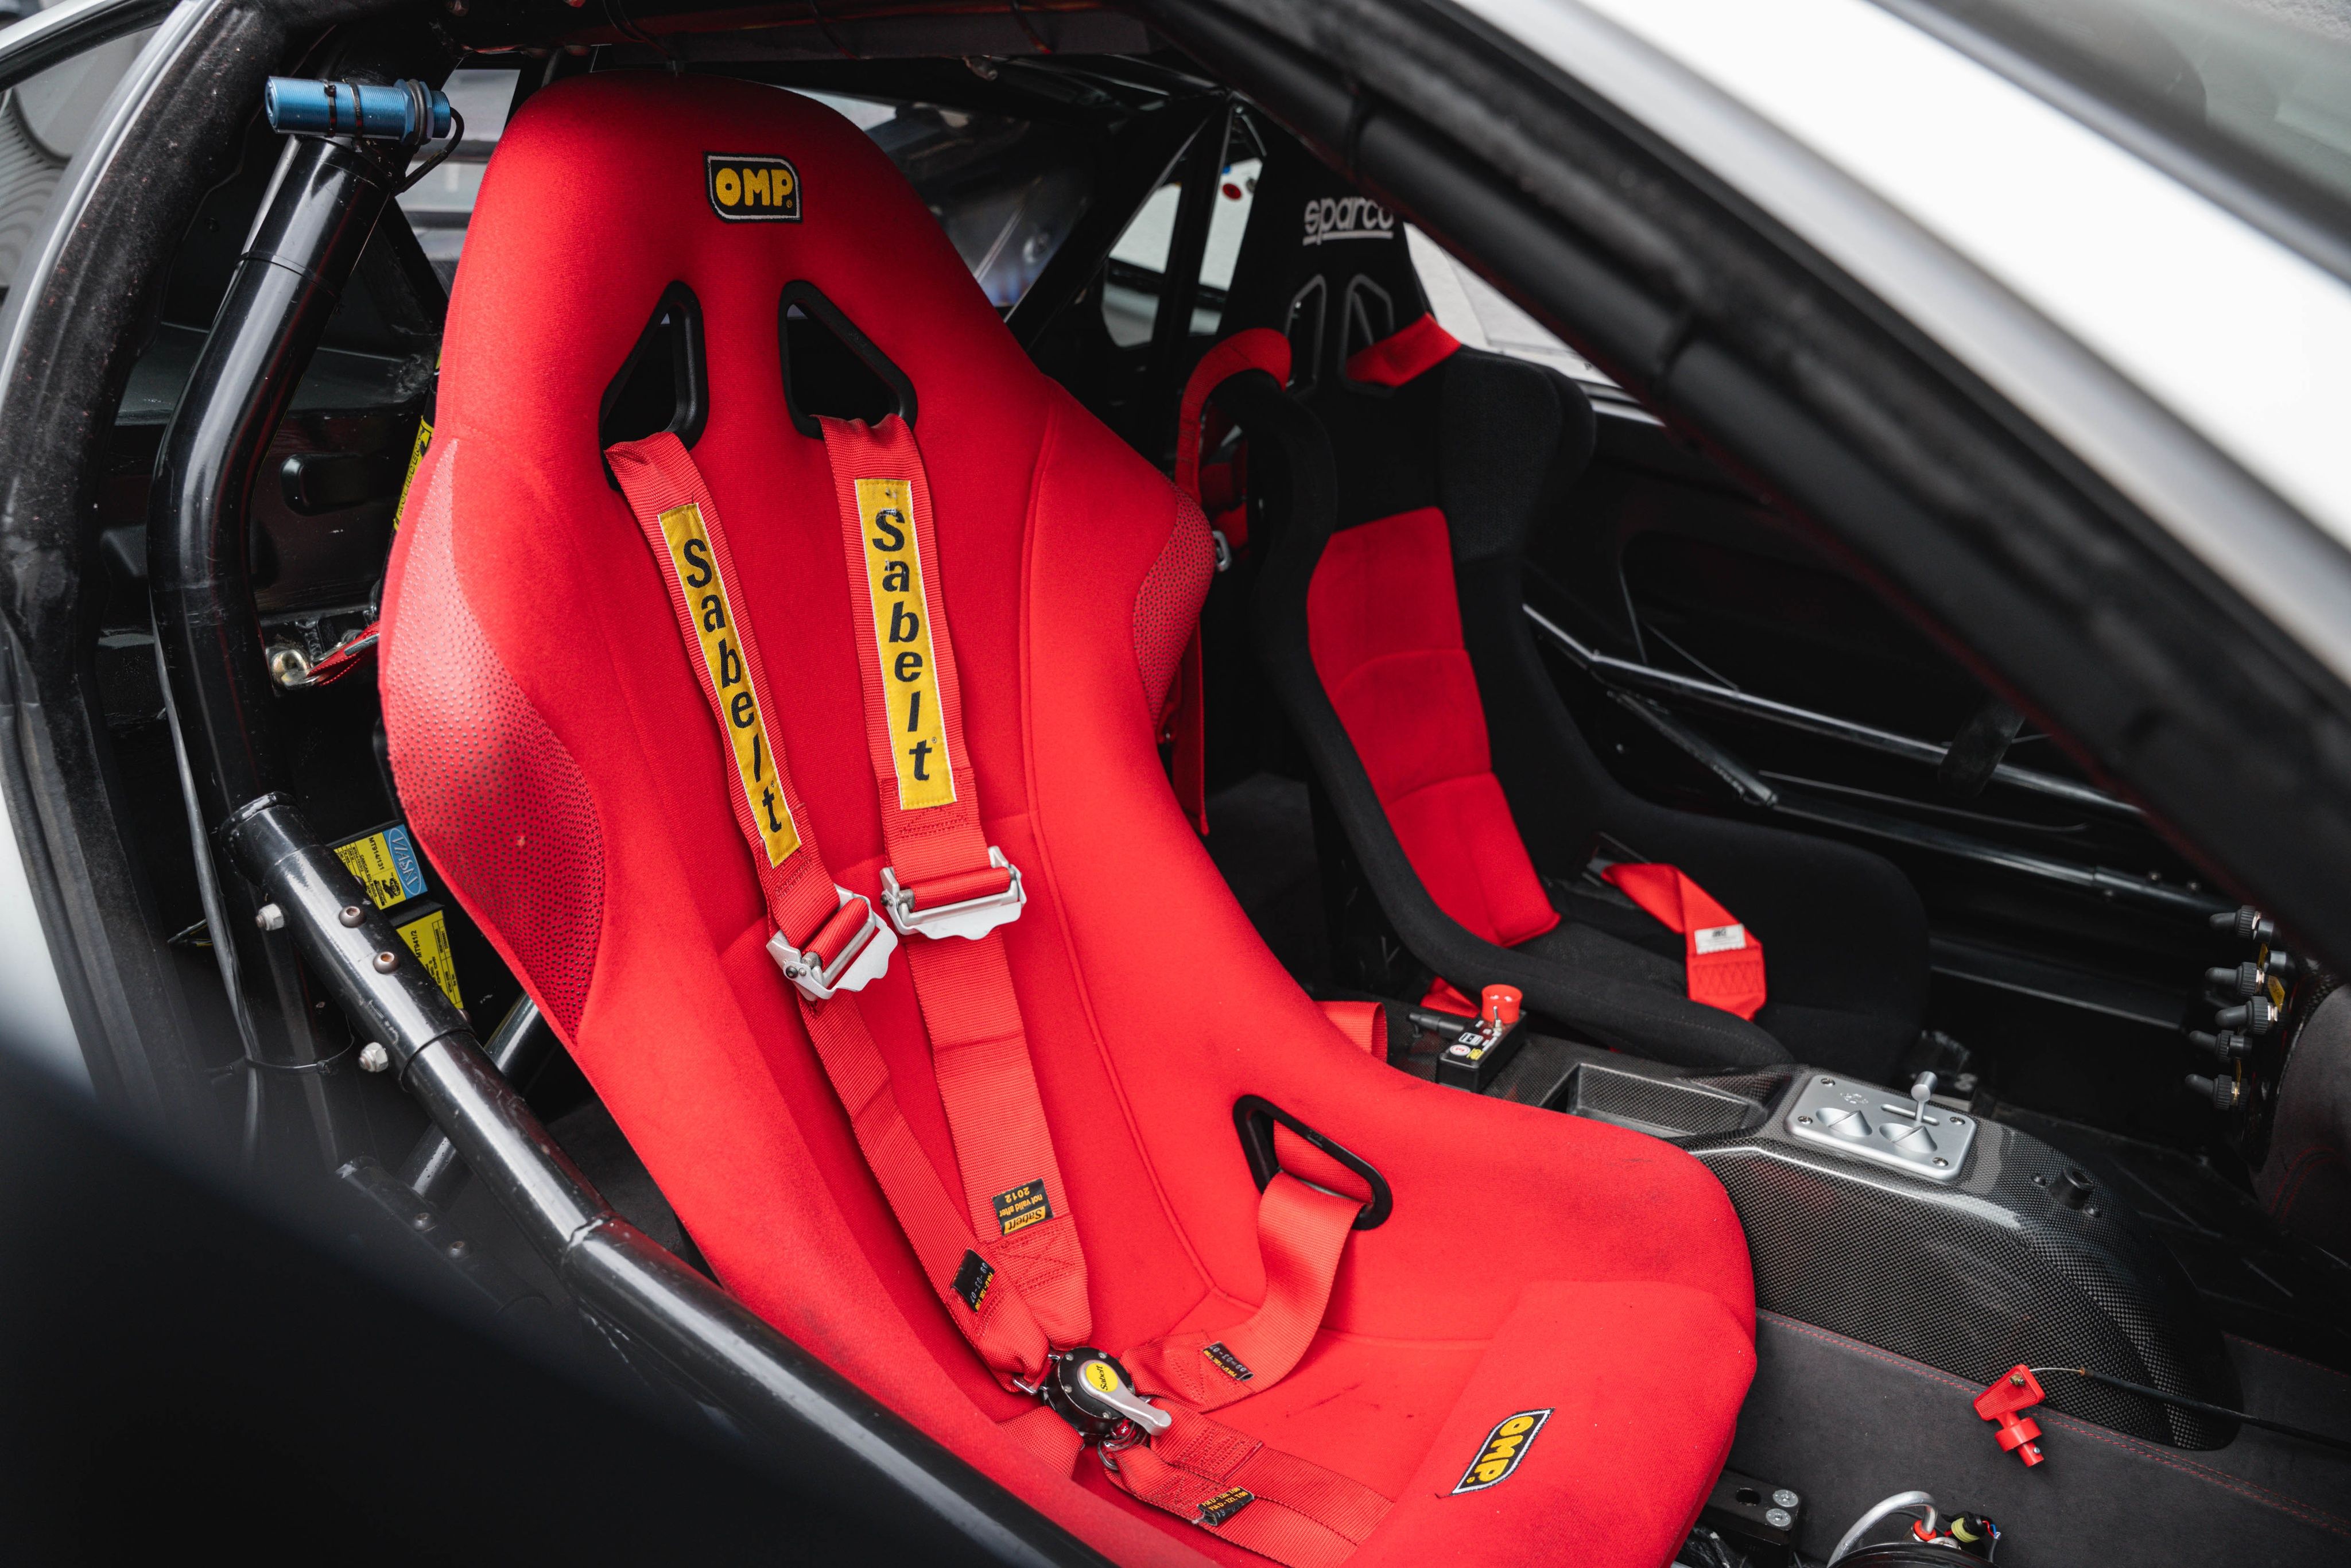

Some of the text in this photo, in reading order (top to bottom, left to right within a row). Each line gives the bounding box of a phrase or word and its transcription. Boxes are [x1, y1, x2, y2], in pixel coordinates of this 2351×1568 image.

[716, 168, 793, 206] OMP
[1303, 197, 1394, 245] sparco
[872, 509, 932, 781] Sabelt
[683, 538, 782, 833] Sabelt
[368, 837, 384, 870] MT914/131
[411, 930, 422, 958] MT941/2
[999, 1194, 1043, 1217] not valid after
[1005, 1187, 1030, 1203] 2012
[1008, 1209, 1042, 1229] Sabelt
[1096, 1365, 1108, 1391] Sabelt
[1475, 1416, 1534, 1482] OMP
